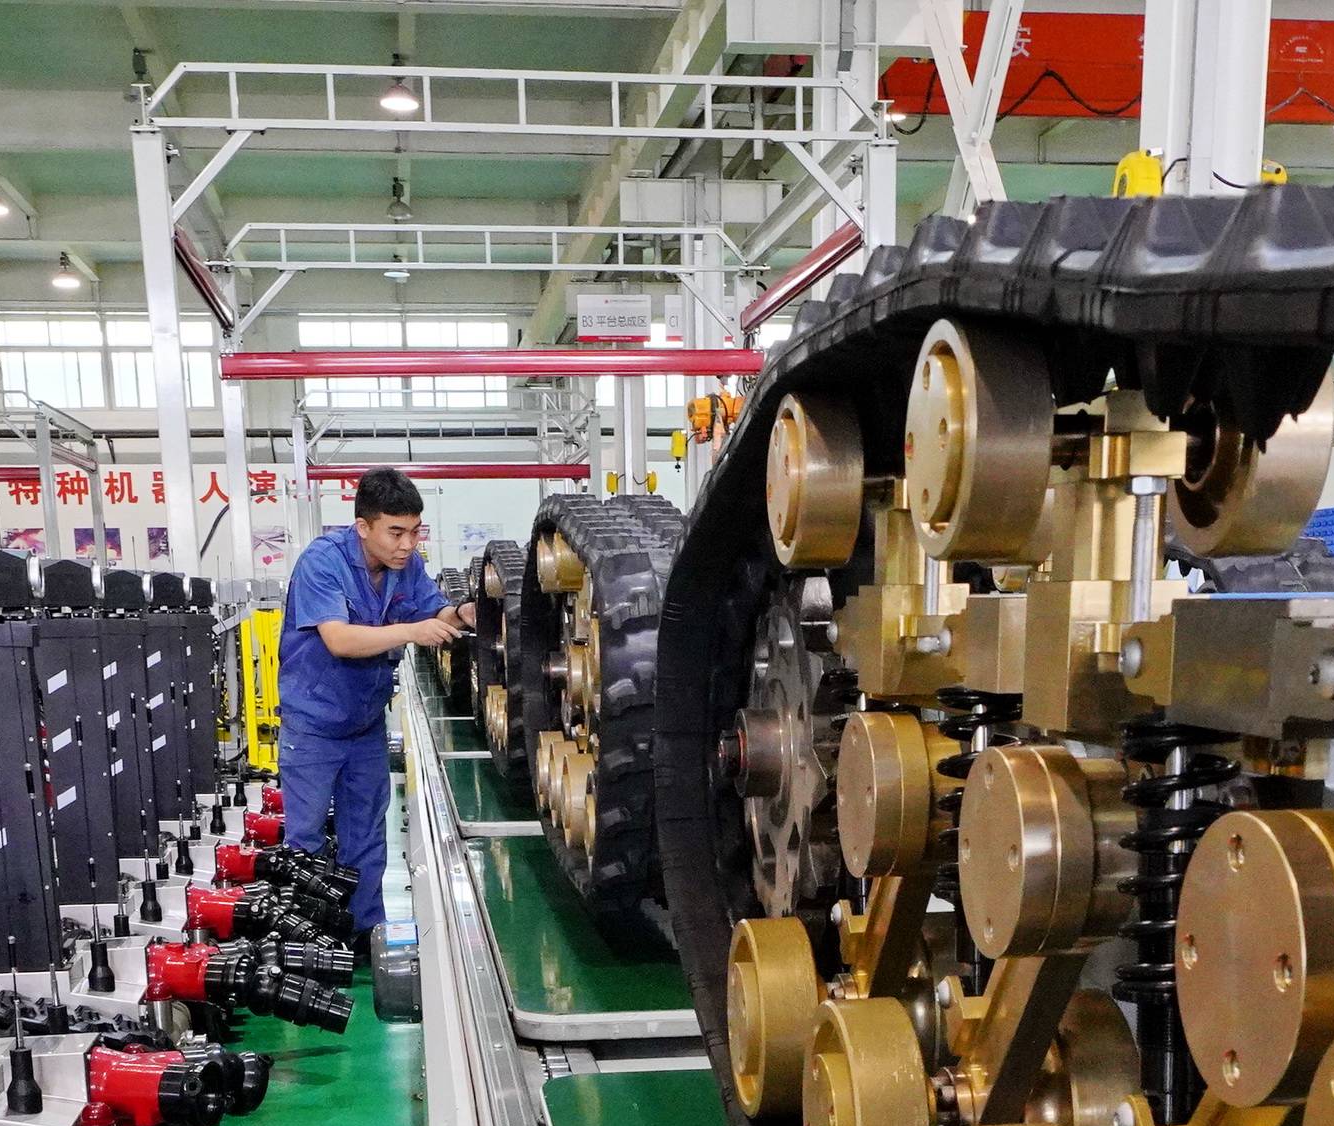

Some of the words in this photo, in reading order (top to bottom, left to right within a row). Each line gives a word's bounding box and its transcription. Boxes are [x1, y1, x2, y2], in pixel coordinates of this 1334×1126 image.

[582, 315, 593, 328] B3
[596, 315, 647, 328] 平台总成区
